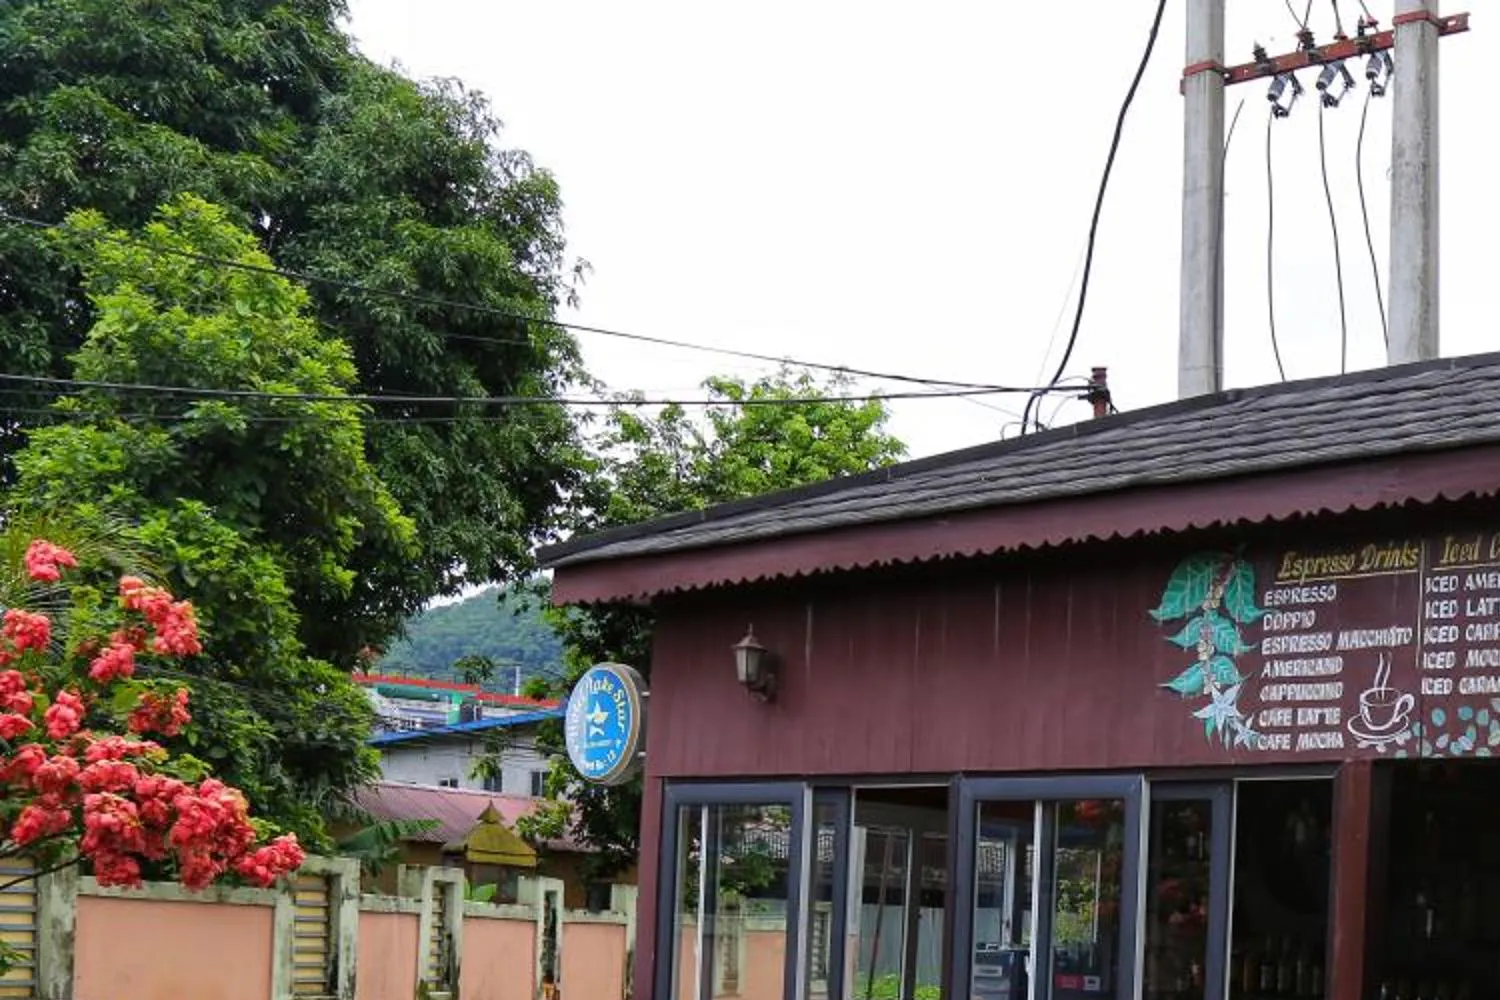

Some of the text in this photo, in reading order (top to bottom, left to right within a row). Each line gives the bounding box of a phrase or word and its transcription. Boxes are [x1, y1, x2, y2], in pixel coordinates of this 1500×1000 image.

[1440, 535, 1482, 564] Iced
[1278, 541, 1419, 584] Espresso Drinks
[1425, 576, 1459, 593] ICED
[1263, 584, 1337, 606] ESPRESSO
[1425, 600, 1459, 619] ICED
[1263, 610, 1316, 630] DOPPIO
[1261, 626, 1412, 655] ESPRESSO MACCHIATO
[1423, 625, 1459, 645] ICED
[1261, 656, 1343, 678] AMERICANO
[1423, 652, 1455, 669] ICED
[1260, 682, 1343, 701] CAPPUCCINO
[1421, 677, 1452, 695] ICED
[1259, 707, 1341, 727] CAFE LATTE
[1257, 731, 1344, 752] CAFE MOCHA
